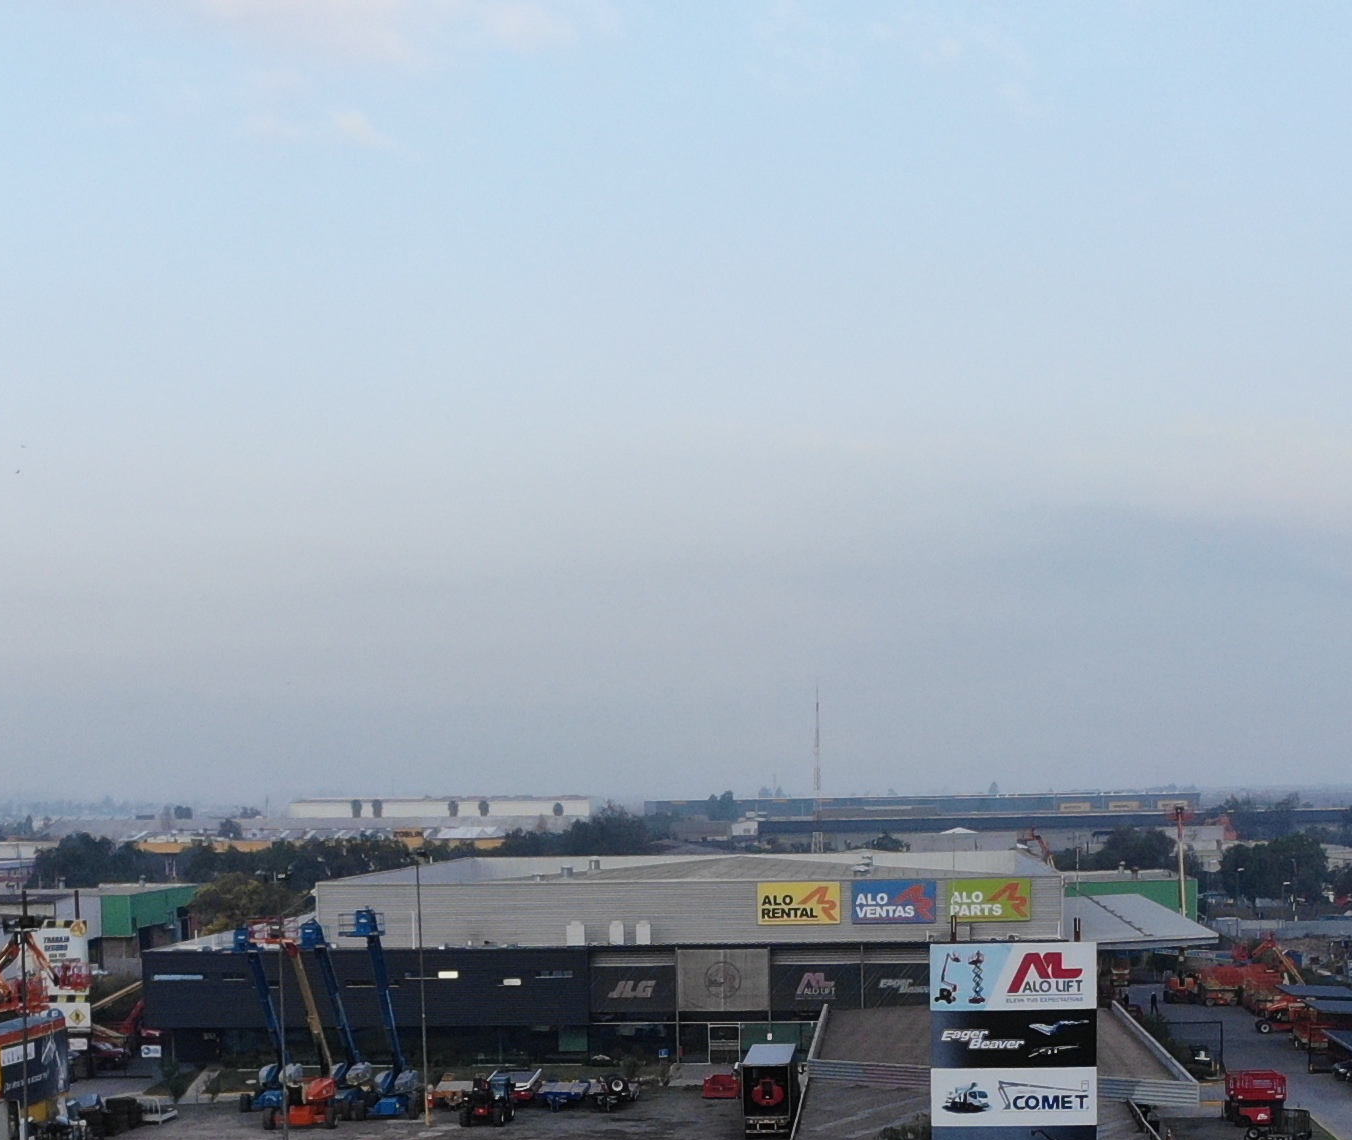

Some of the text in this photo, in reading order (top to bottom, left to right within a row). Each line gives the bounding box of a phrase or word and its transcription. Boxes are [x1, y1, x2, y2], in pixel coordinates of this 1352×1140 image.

[761, 895, 794, 906] ALO
[855, 893, 888, 905] ALO
[950, 892, 983, 904] ALO
[761, 907, 818, 919] RENTAL
[856, 905, 915, 918] VENTAS
[950, 904, 1002, 916] PARTS
[608, 979, 657, 998] JLG
[1022, 979, 1084, 994] ALO LIFT
[941, 1029, 990, 1042] Eager
[968, 1039, 1026, 1050] Beaver
